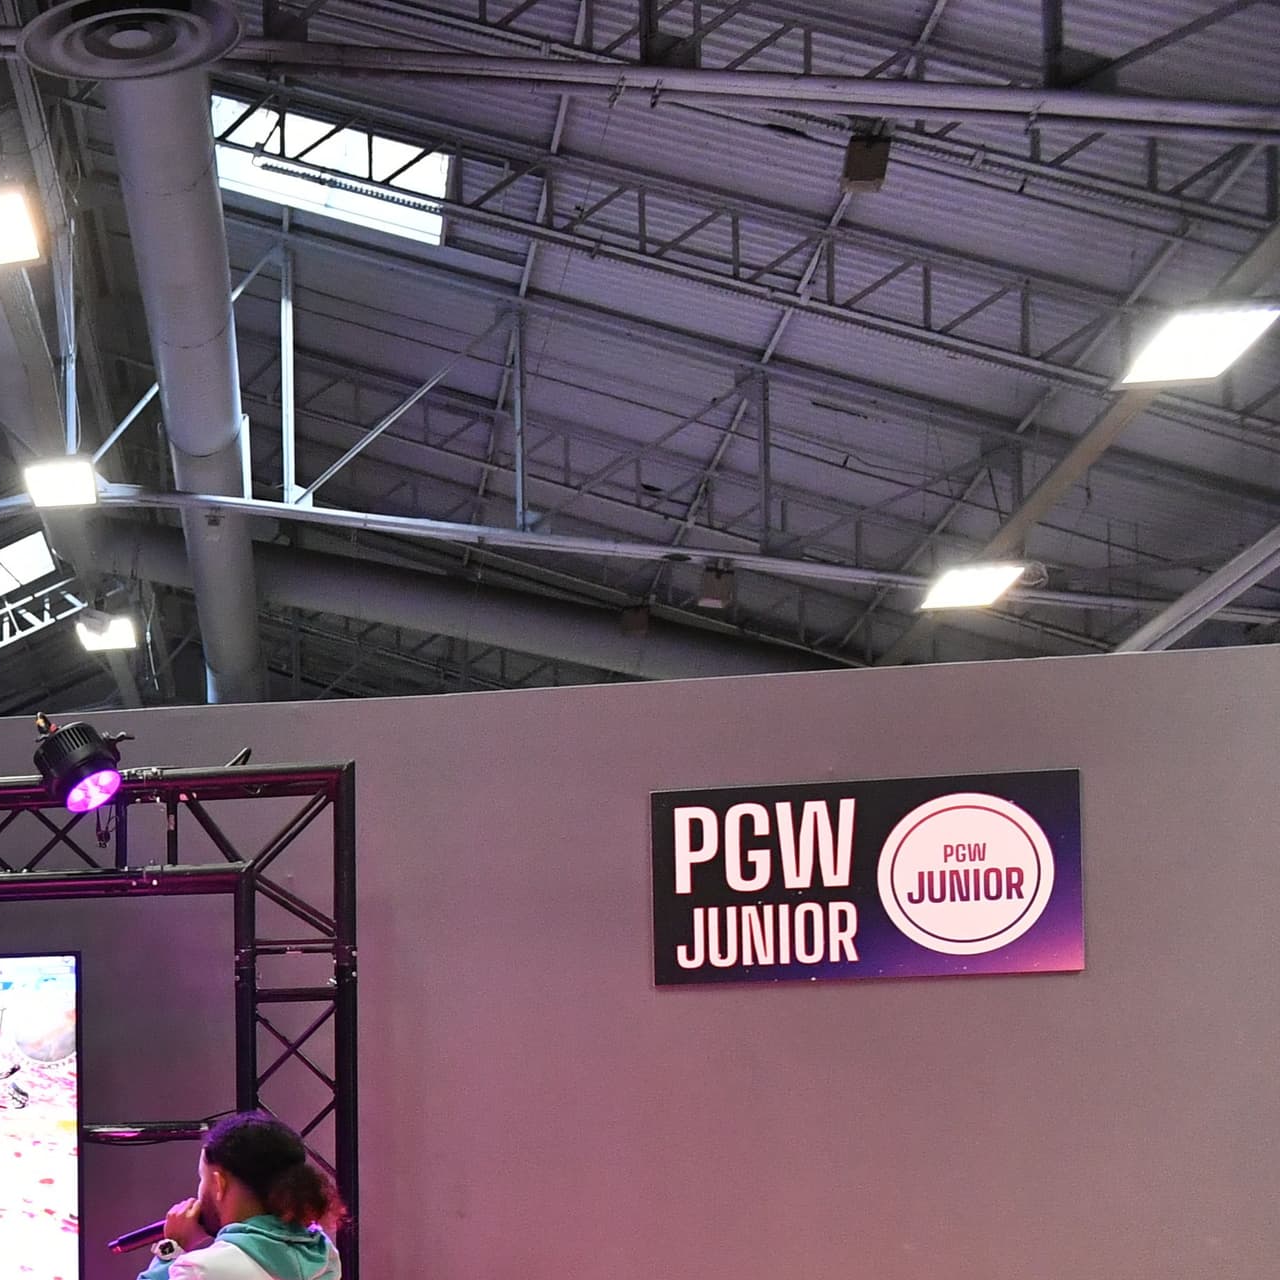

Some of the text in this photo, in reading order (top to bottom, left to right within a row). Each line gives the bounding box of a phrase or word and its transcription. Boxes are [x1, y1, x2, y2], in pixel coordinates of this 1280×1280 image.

[674, 798, 855, 894] PGW
[943, 843, 986, 863] PGW
[907, 866, 1024, 904] JUNIOR
[676, 901, 859, 969] JUNIOR
